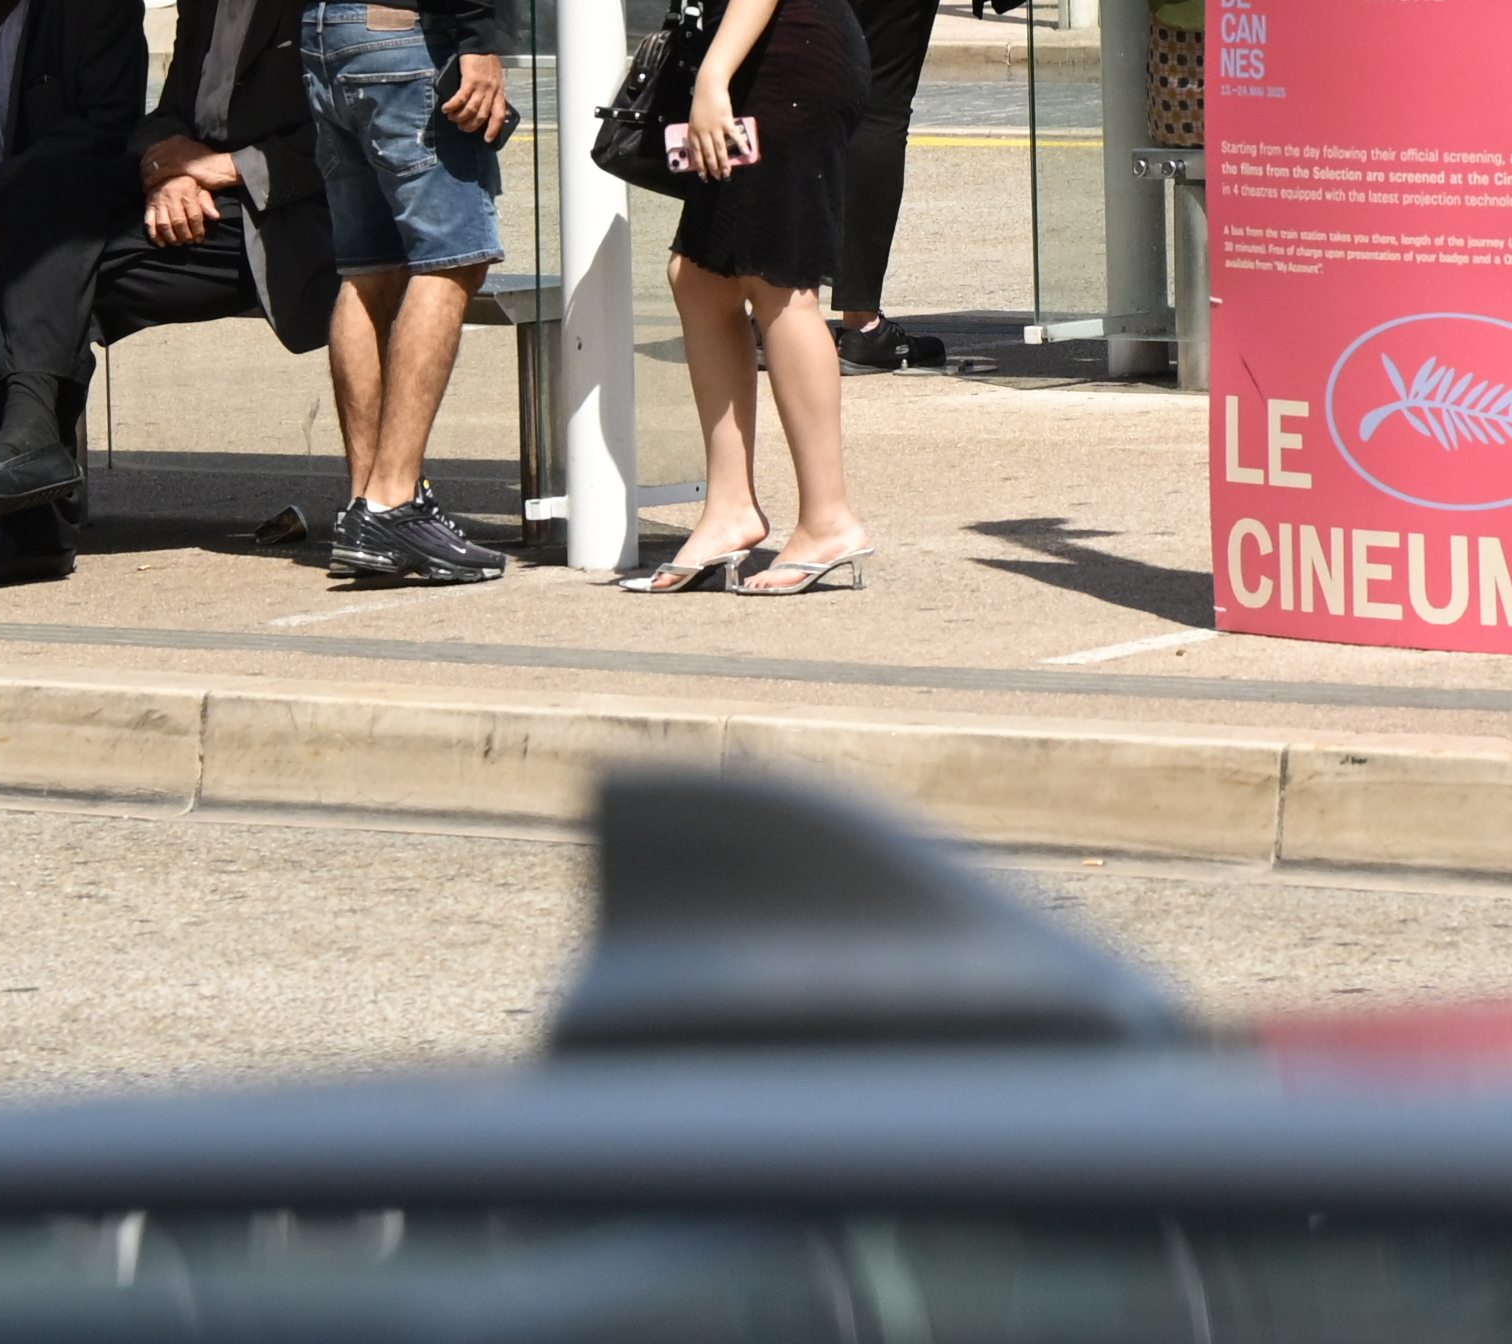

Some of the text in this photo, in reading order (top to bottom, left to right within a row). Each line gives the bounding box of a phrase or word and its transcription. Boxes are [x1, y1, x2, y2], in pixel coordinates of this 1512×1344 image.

[1221, 12, 1267, 44] CAN
[1220, 48, 1266, 80] NES
[1221, 140, 1257, 157] Starting
[1259, 142, 1282, 156] from
[1285, 144, 1300, 157] the
[1303, 144, 1320, 160] day
[1323, 145, 1366, 162] following
[1371, 149, 1396, 161] their
[1400, 149, 1439, 163] official
[1443, 151, 1505, 166] screening,
[1221, 162, 1237, 175] the
[1240, 162, 1263, 176] films
[1266, 163, 1289, 177] from
[1292, 166, 1309, 179] the
[1312, 166, 1362, 181] Selection
[1366, 171, 1385, 182] are
[1389, 171, 1445, 184] screened
[1449, 172, 1463, 185] at
[1468, 172, 1489, 186] the
[1222, 182, 1230, 195] in
[1232, 183, 1239, 196] 4
[1241, 183, 1278, 198] theatres
[1281, 186, 1323, 202] equipped
[1325, 188, 1345, 201] with
[1349, 188, 1366, 203] the
[1368, 190, 1399, 204] latest
[1402, 192, 1461, 208] projection
[1231, 224, 1244, 236] bus
[1224, 395, 1312, 489] LE
